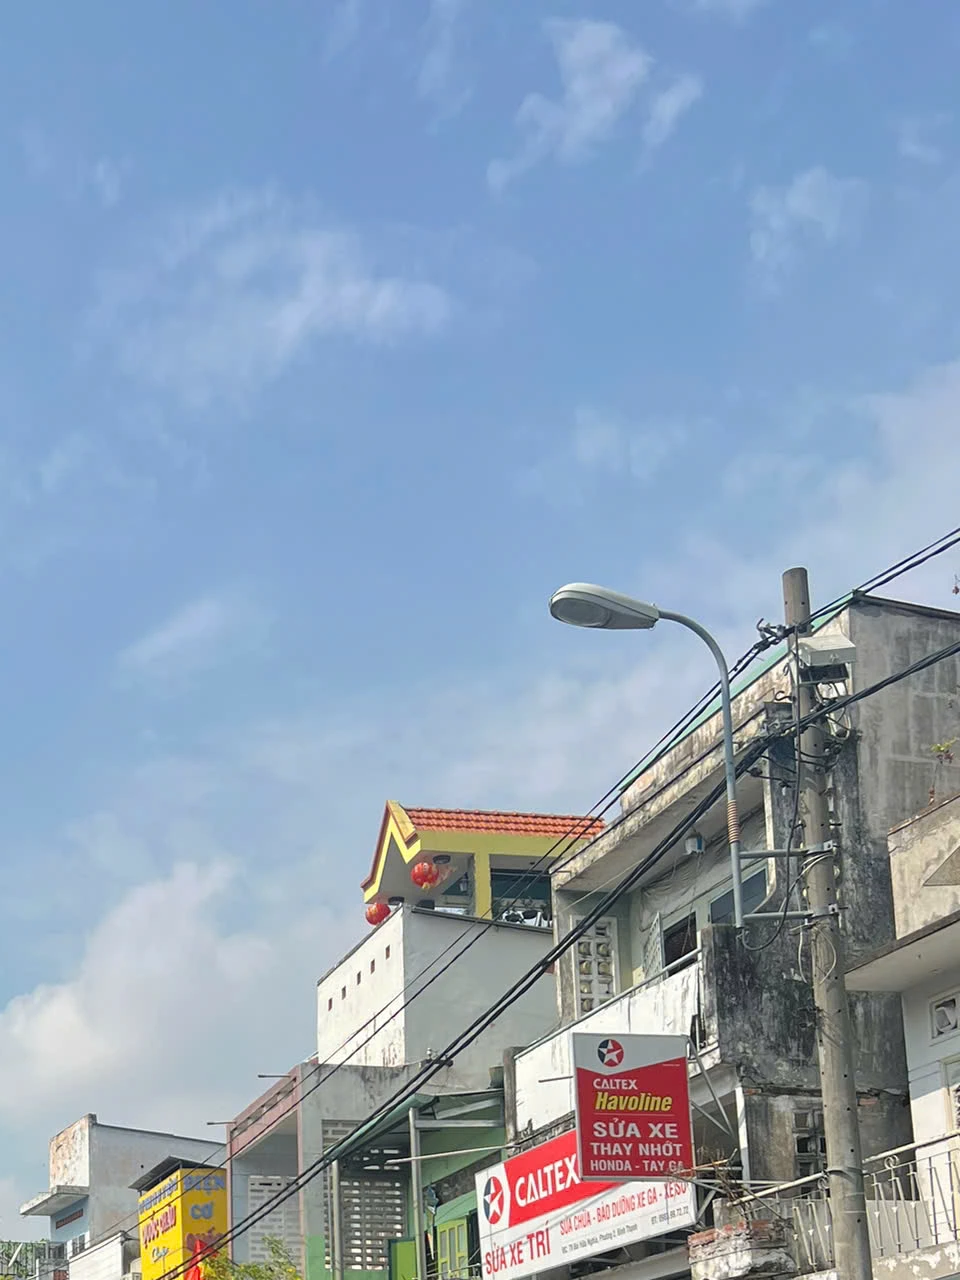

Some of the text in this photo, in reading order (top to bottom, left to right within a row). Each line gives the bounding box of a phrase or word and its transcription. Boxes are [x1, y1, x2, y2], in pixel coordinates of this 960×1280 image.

[593, 1079, 638, 1090] CALTEX
[595, 1092, 673, 1111] Havoline
[593, 1118, 679, 1138] SỬA XE
[590, 1140, 683, 1156] THAY NHỚT
[590, 1160, 632, 1172] HONDA
[643, 1160, 665, 1172] TAY
[515, 1153, 580, 1208] CALTEX
[636, 1191, 646, 1209] XE
[647, 1187, 658, 1205] GA
[485, 1220, 551, 1274] SỬA XE TRÍ
